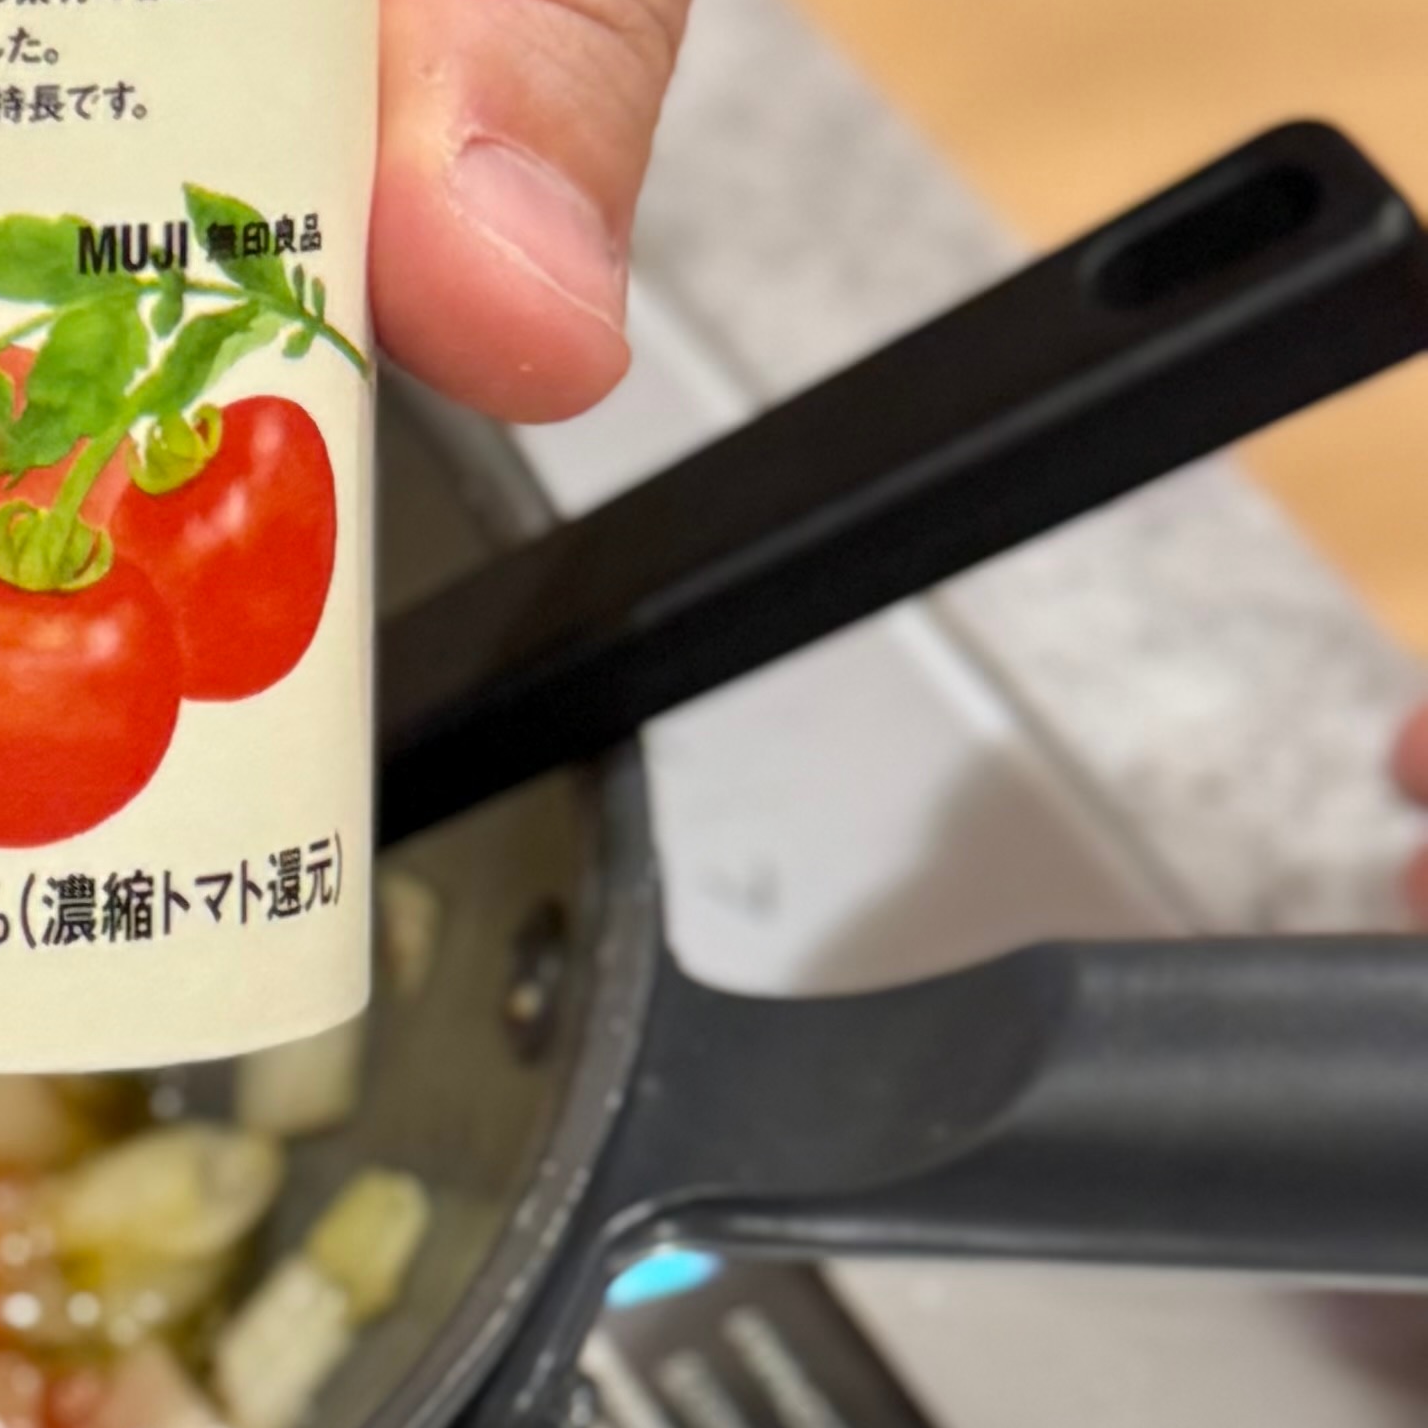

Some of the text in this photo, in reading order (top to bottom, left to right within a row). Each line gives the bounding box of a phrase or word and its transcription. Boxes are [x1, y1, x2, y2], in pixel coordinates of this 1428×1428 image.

[78, 213, 324, 274] MUJI 無印良品
